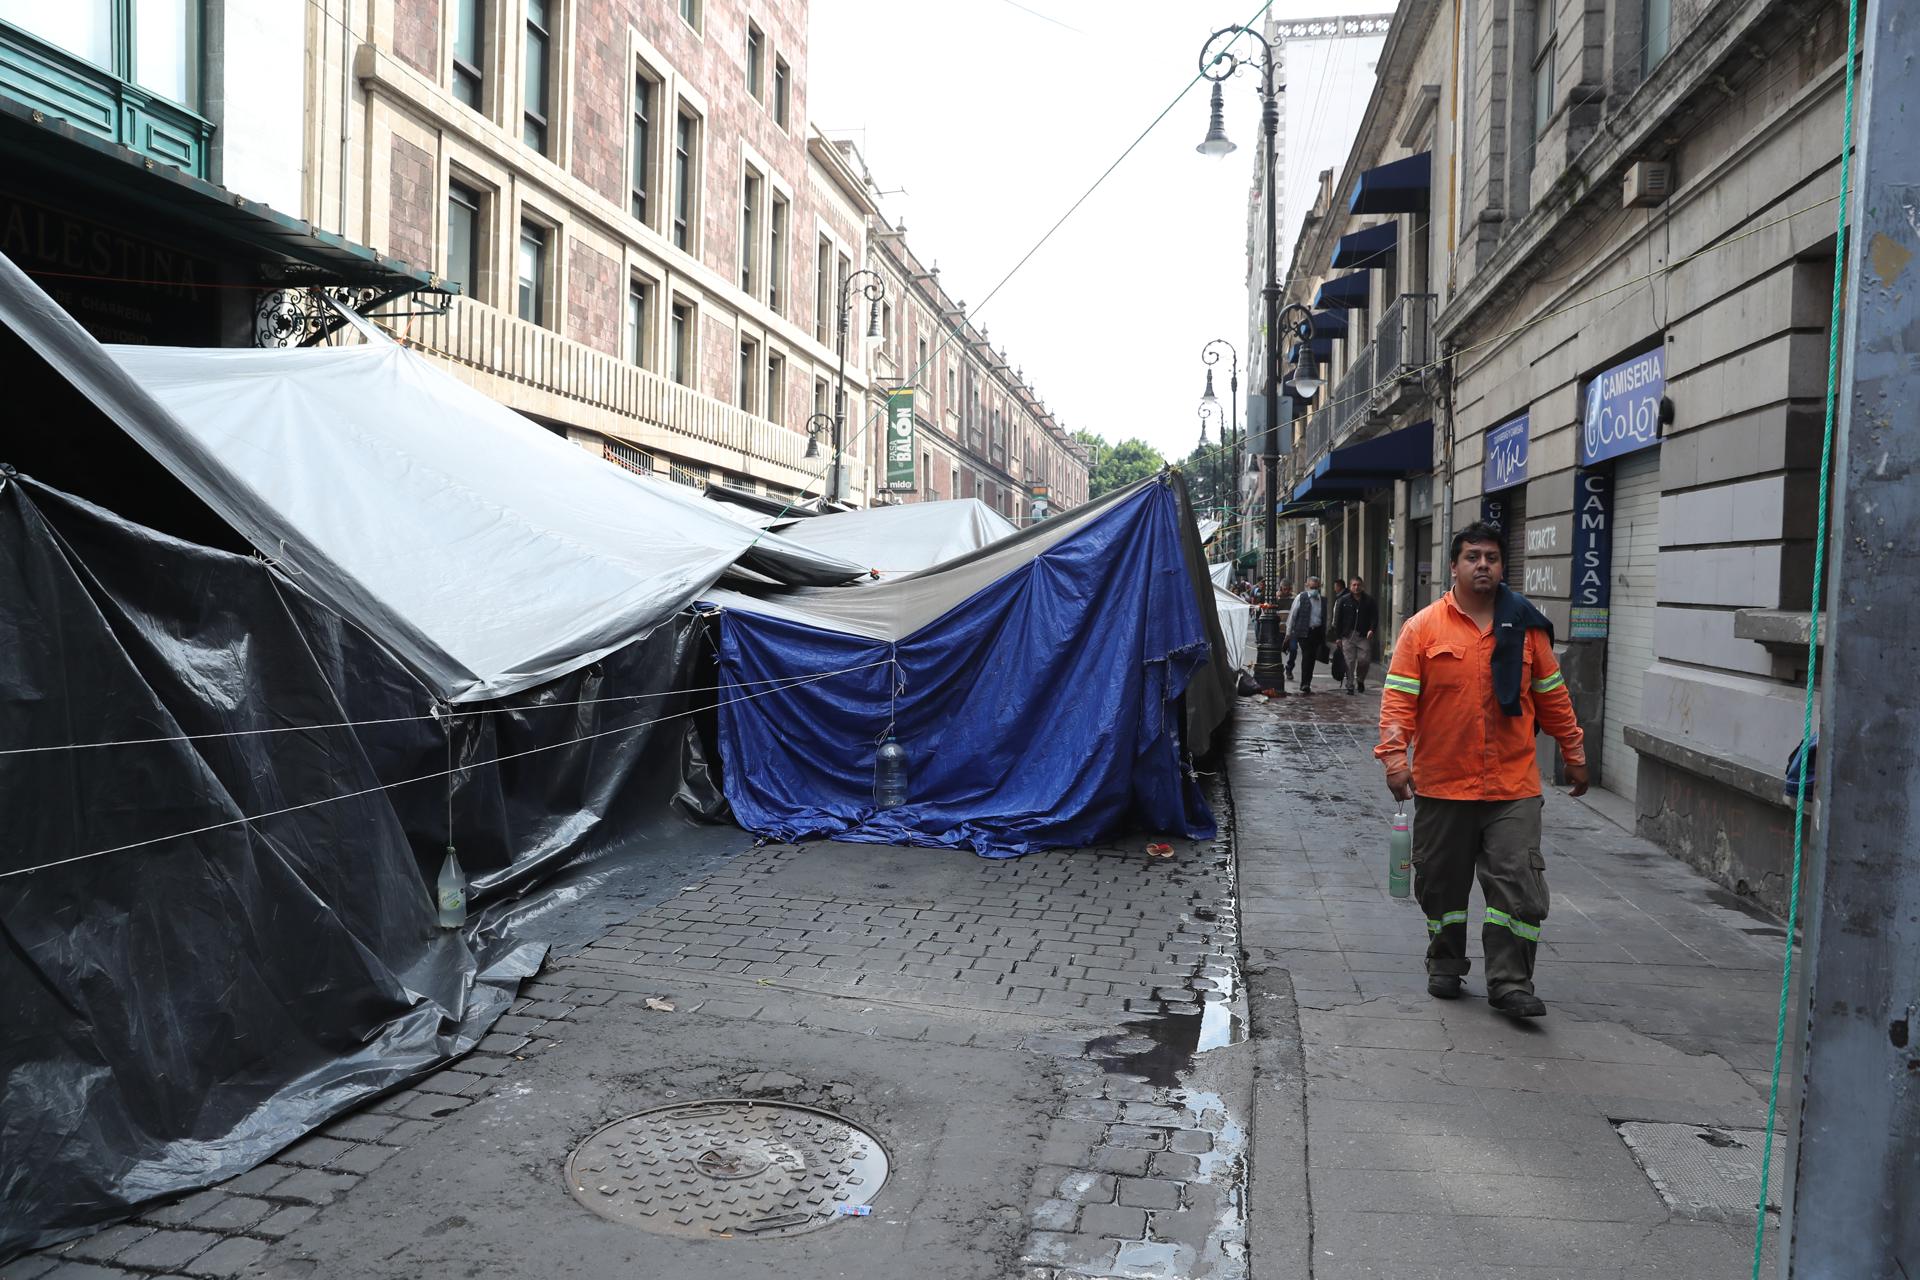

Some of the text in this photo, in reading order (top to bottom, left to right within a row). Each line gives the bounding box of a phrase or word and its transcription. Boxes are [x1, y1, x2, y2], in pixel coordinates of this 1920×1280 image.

[1602, 356, 1661, 400] CAMISERIA
[889, 440, 897, 461] PASA
[891, 407, 912, 461] BALÓN
[1489, 502, 1502, 532] GUA
[1580, 476, 1605, 605] CAMISAS
